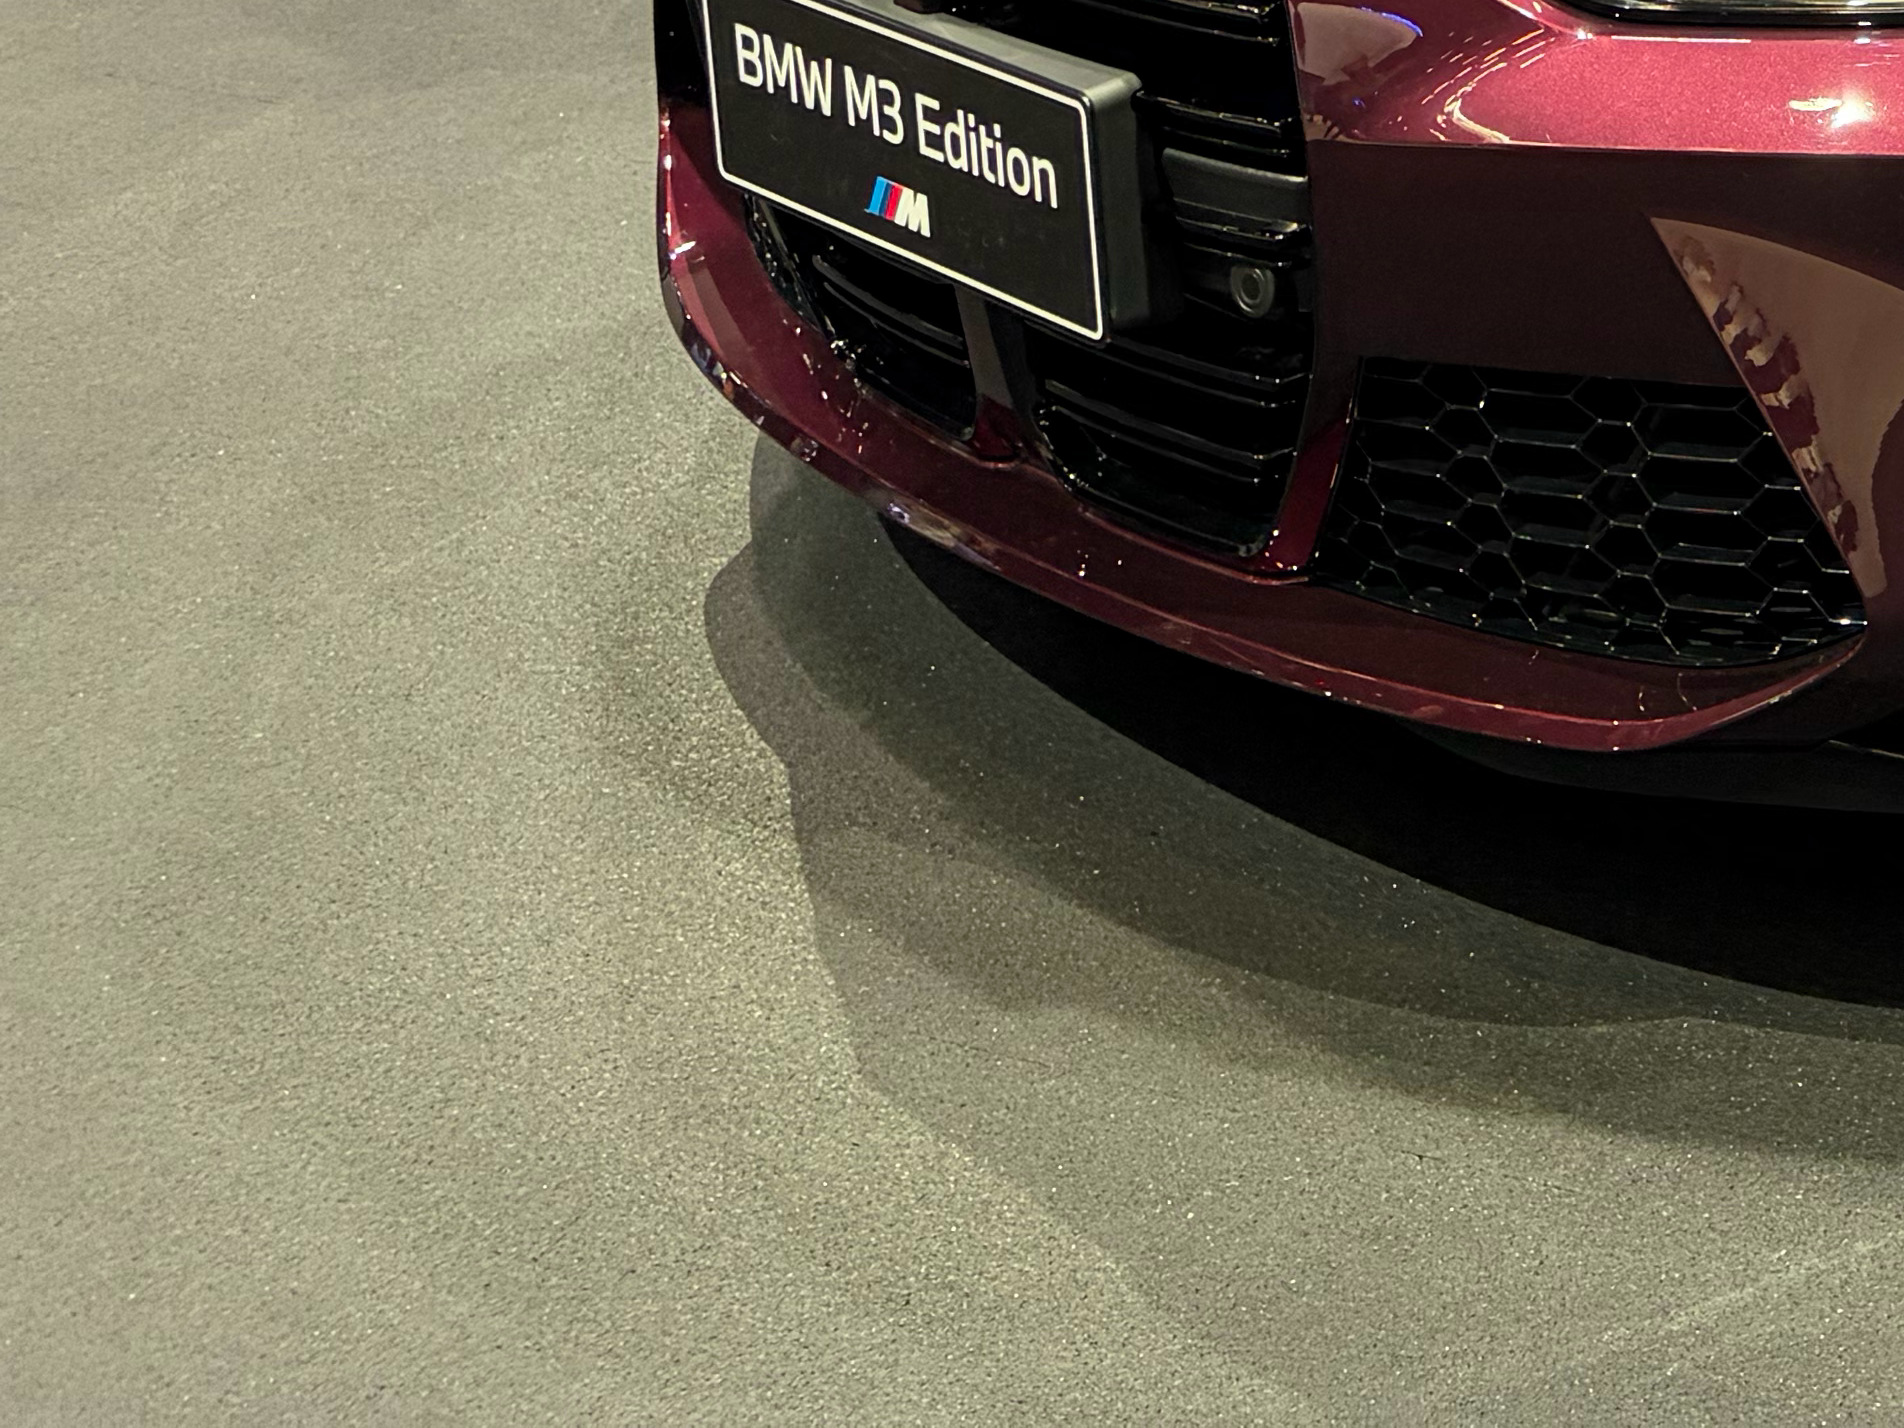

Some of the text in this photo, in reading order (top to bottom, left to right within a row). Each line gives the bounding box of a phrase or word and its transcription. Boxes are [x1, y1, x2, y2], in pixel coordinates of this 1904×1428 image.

[734, 22, 1058, 209] BMW M3 Edition
